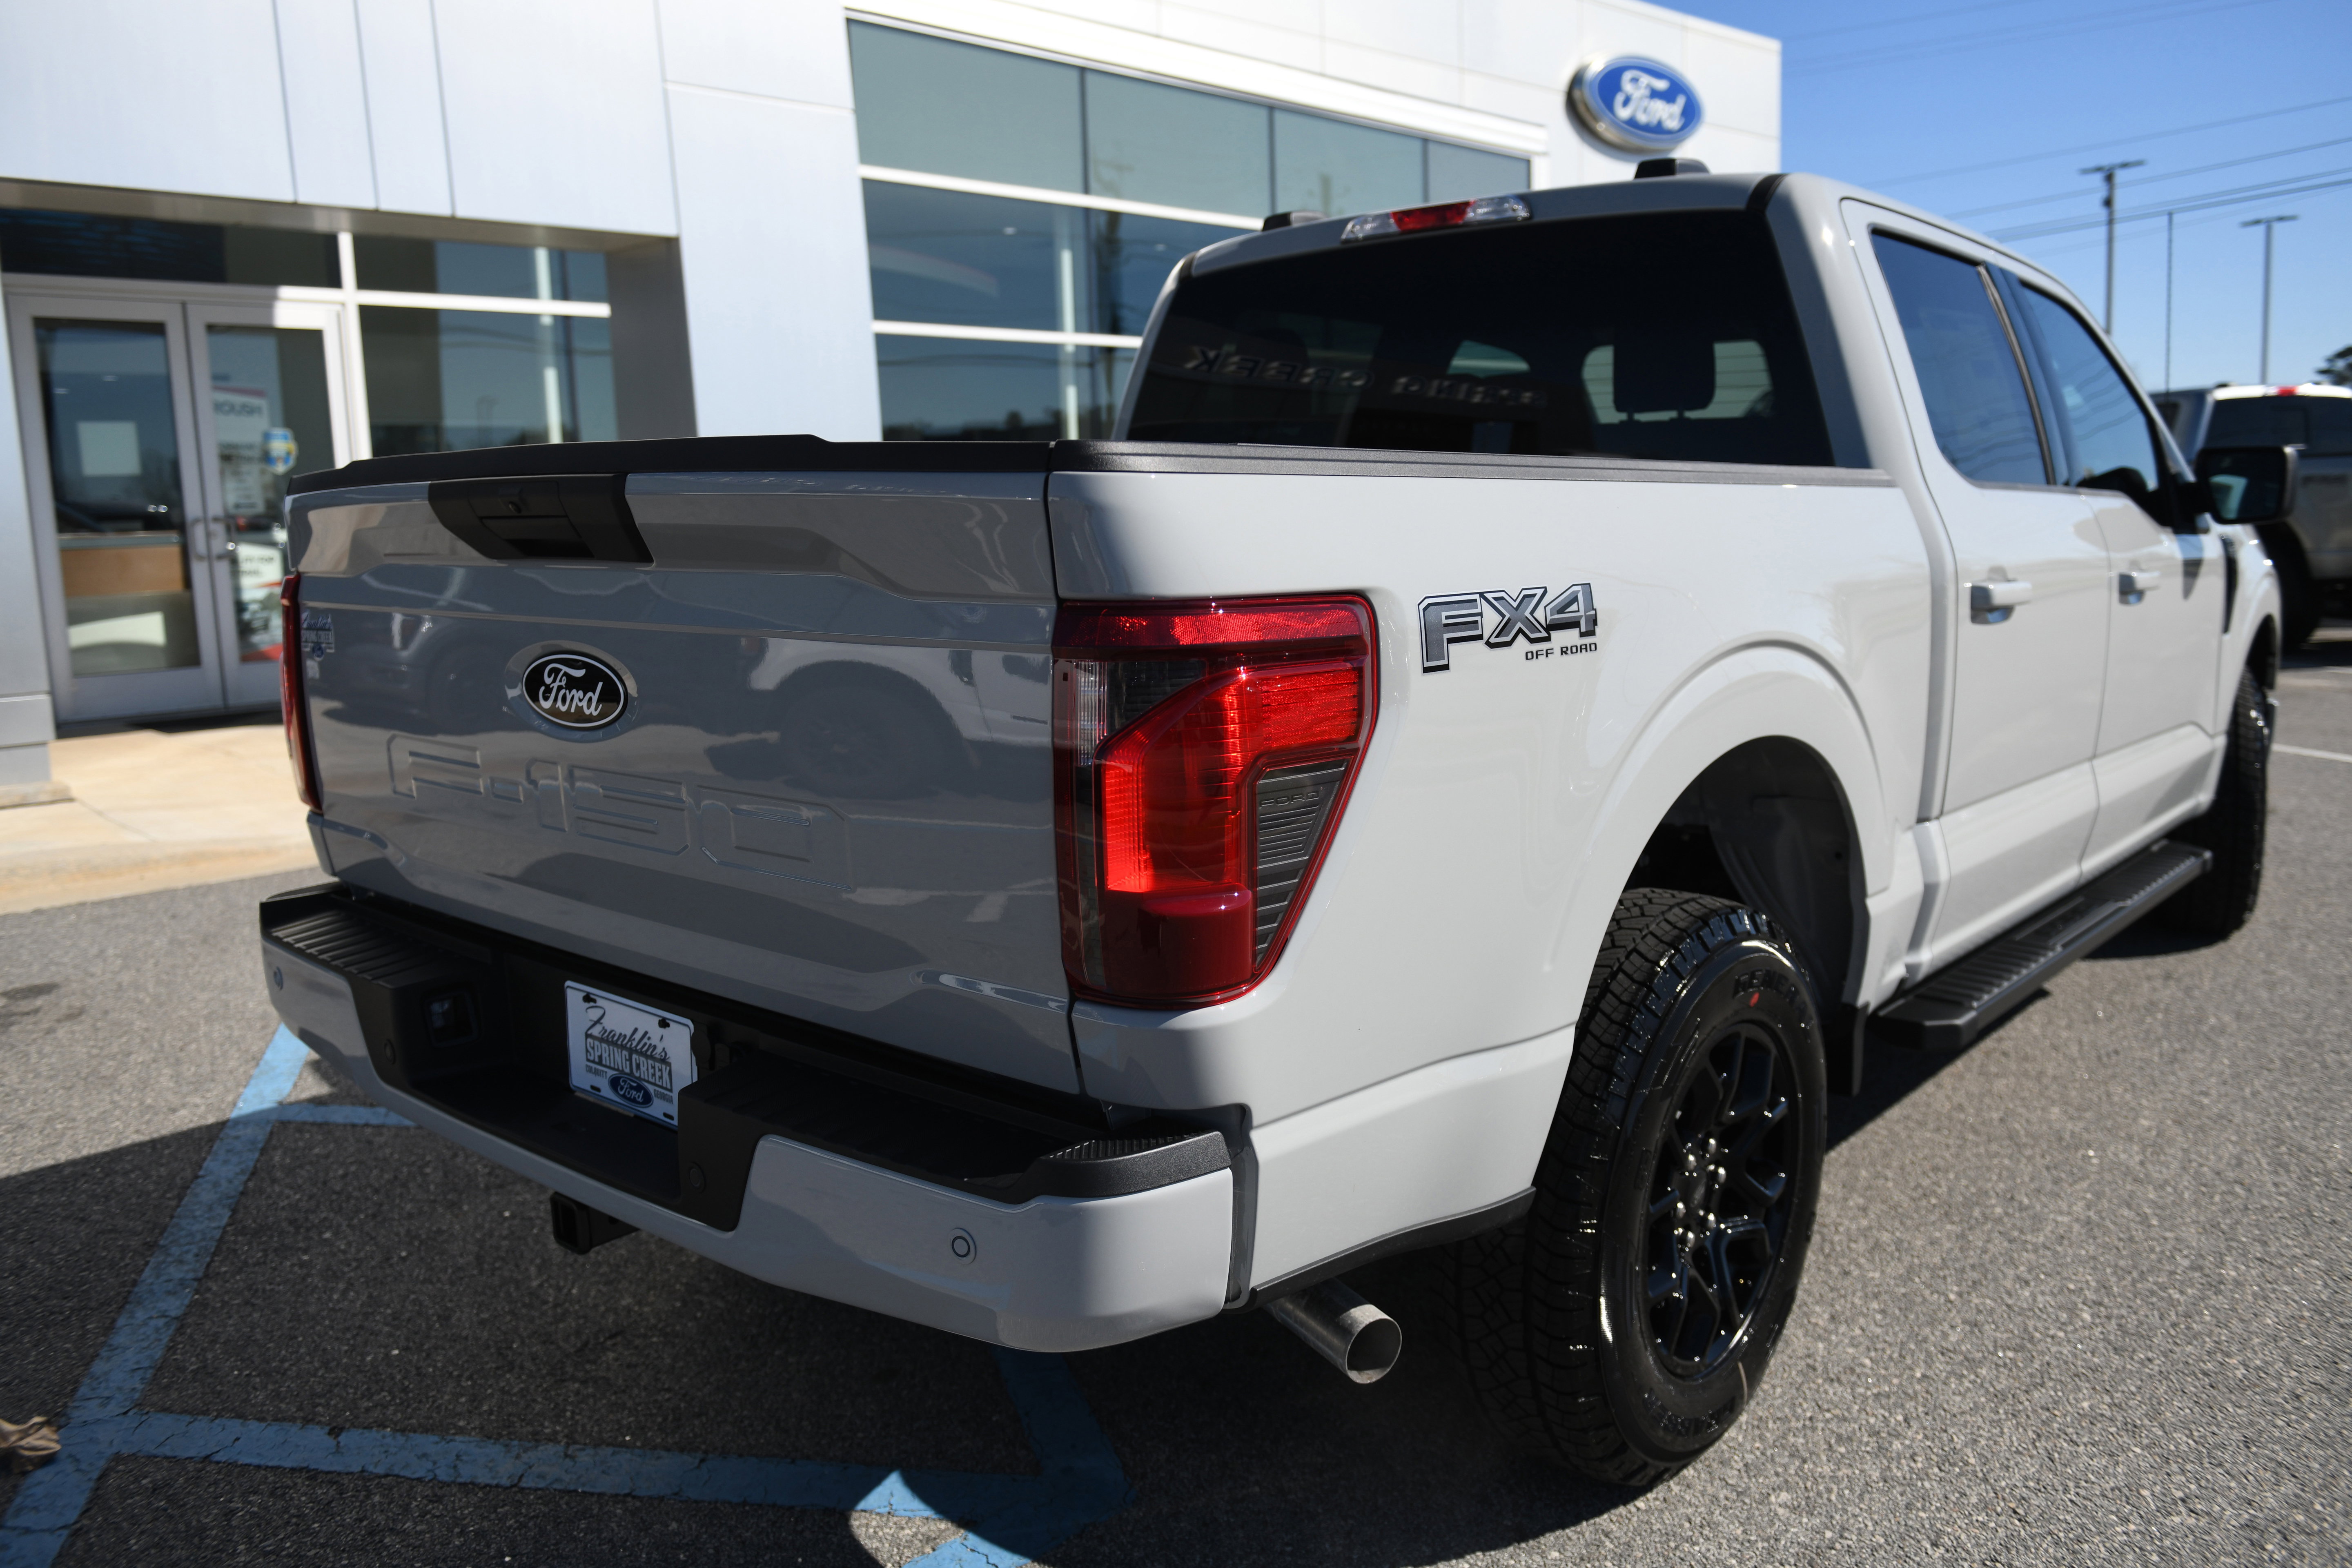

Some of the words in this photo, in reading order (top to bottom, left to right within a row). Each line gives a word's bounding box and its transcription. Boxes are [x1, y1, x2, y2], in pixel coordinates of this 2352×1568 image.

[1613, 69, 1687, 132] Ford
[1417, 583, 1598, 674] FX4
[1525, 648, 1555, 661] OFF
[1560, 642, 1597, 656] ROAD
[539, 663, 603, 717] Ford
[386, 732, 853, 891] F-150
[1258, 790, 1320, 809] FORD
[1732, 966, 1815, 1039] GENERAL
[585, 1005, 670, 1061] Franklin's
[585, 1064, 608, 1080] COLQUITT
[586, 1038, 630, 1074] SPRING
[632, 1054, 671, 1090] CREEK
[618, 1077, 644, 1103] Ford
[653, 1089, 674, 1105] GEORGIA
